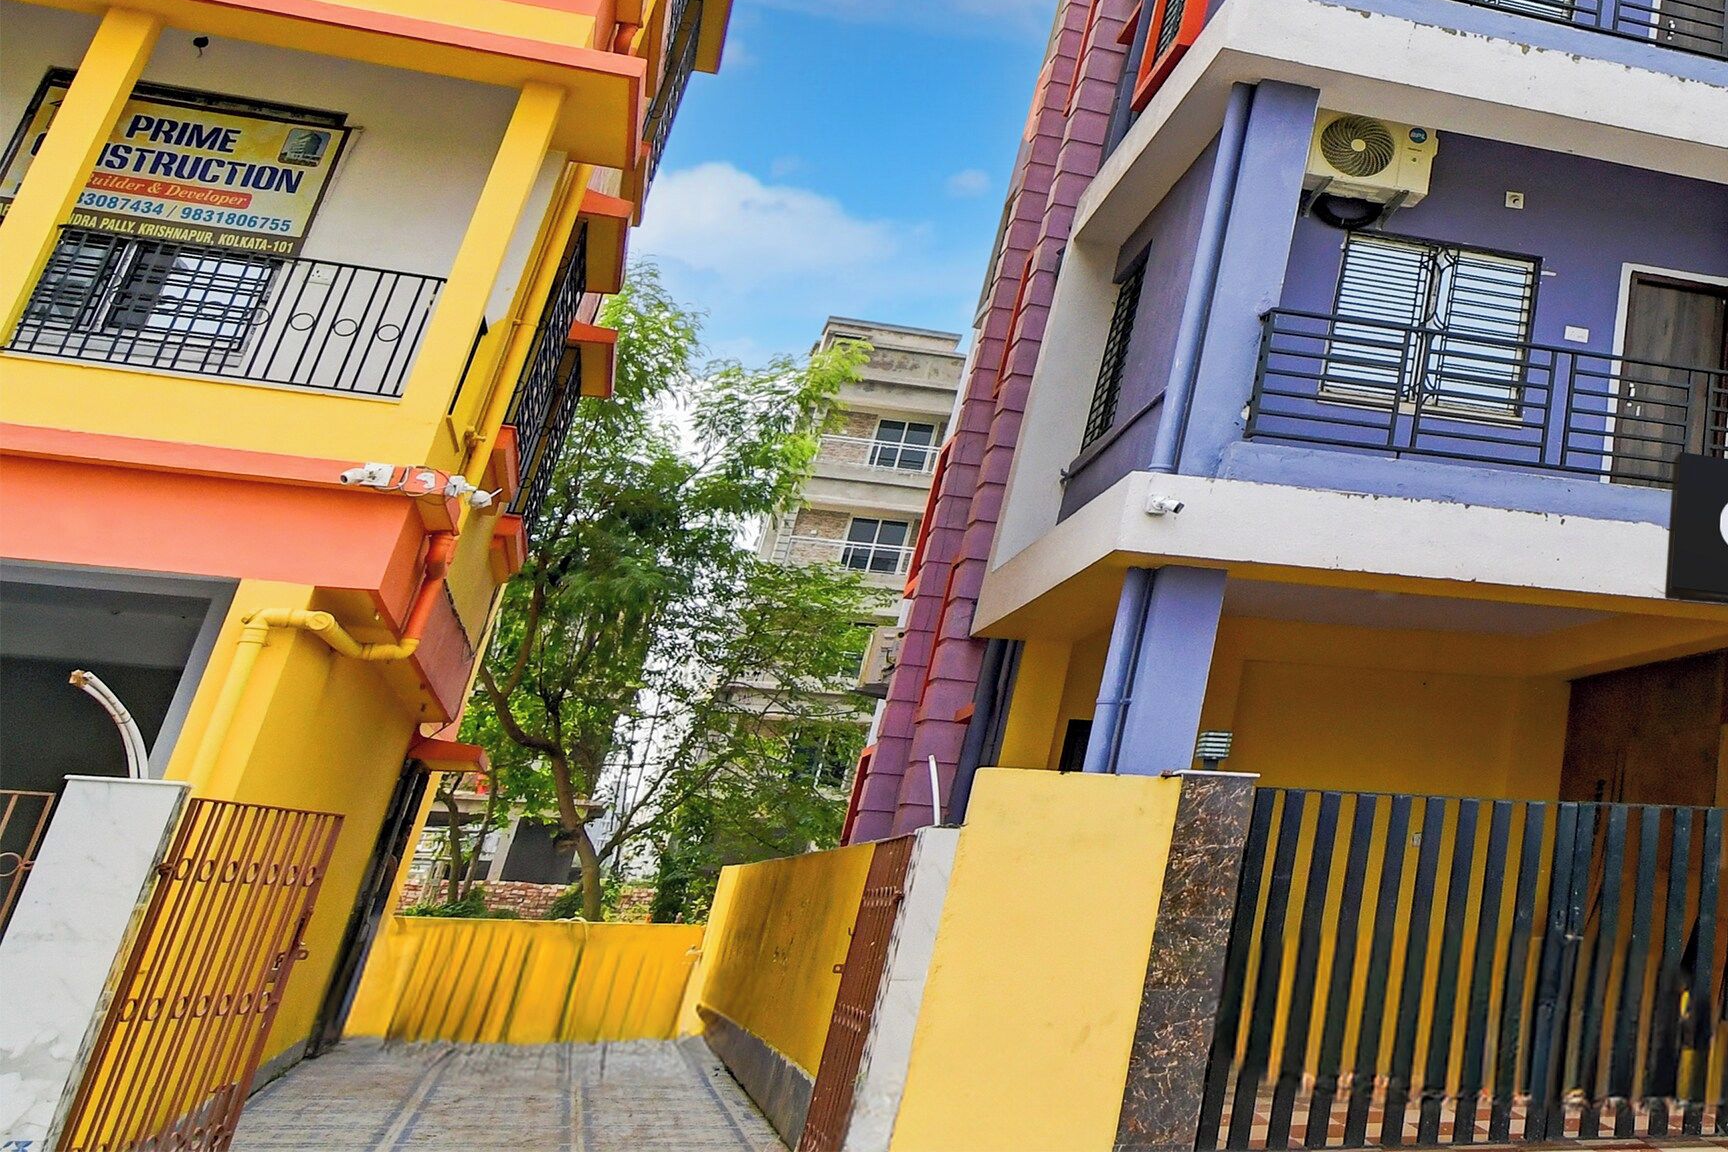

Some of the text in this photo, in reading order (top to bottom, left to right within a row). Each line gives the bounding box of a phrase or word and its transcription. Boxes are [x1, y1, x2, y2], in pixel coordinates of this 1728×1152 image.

[126, 114, 242, 154] PRIME
[147, 182, 162, 194] &
[166, 187, 248, 206] Developer
[180, 206, 292, 233] 9831806755
[138, 222, 215, 246] KRISHNAPUR,
[217, 233, 294, 254] KOLKATA-101
